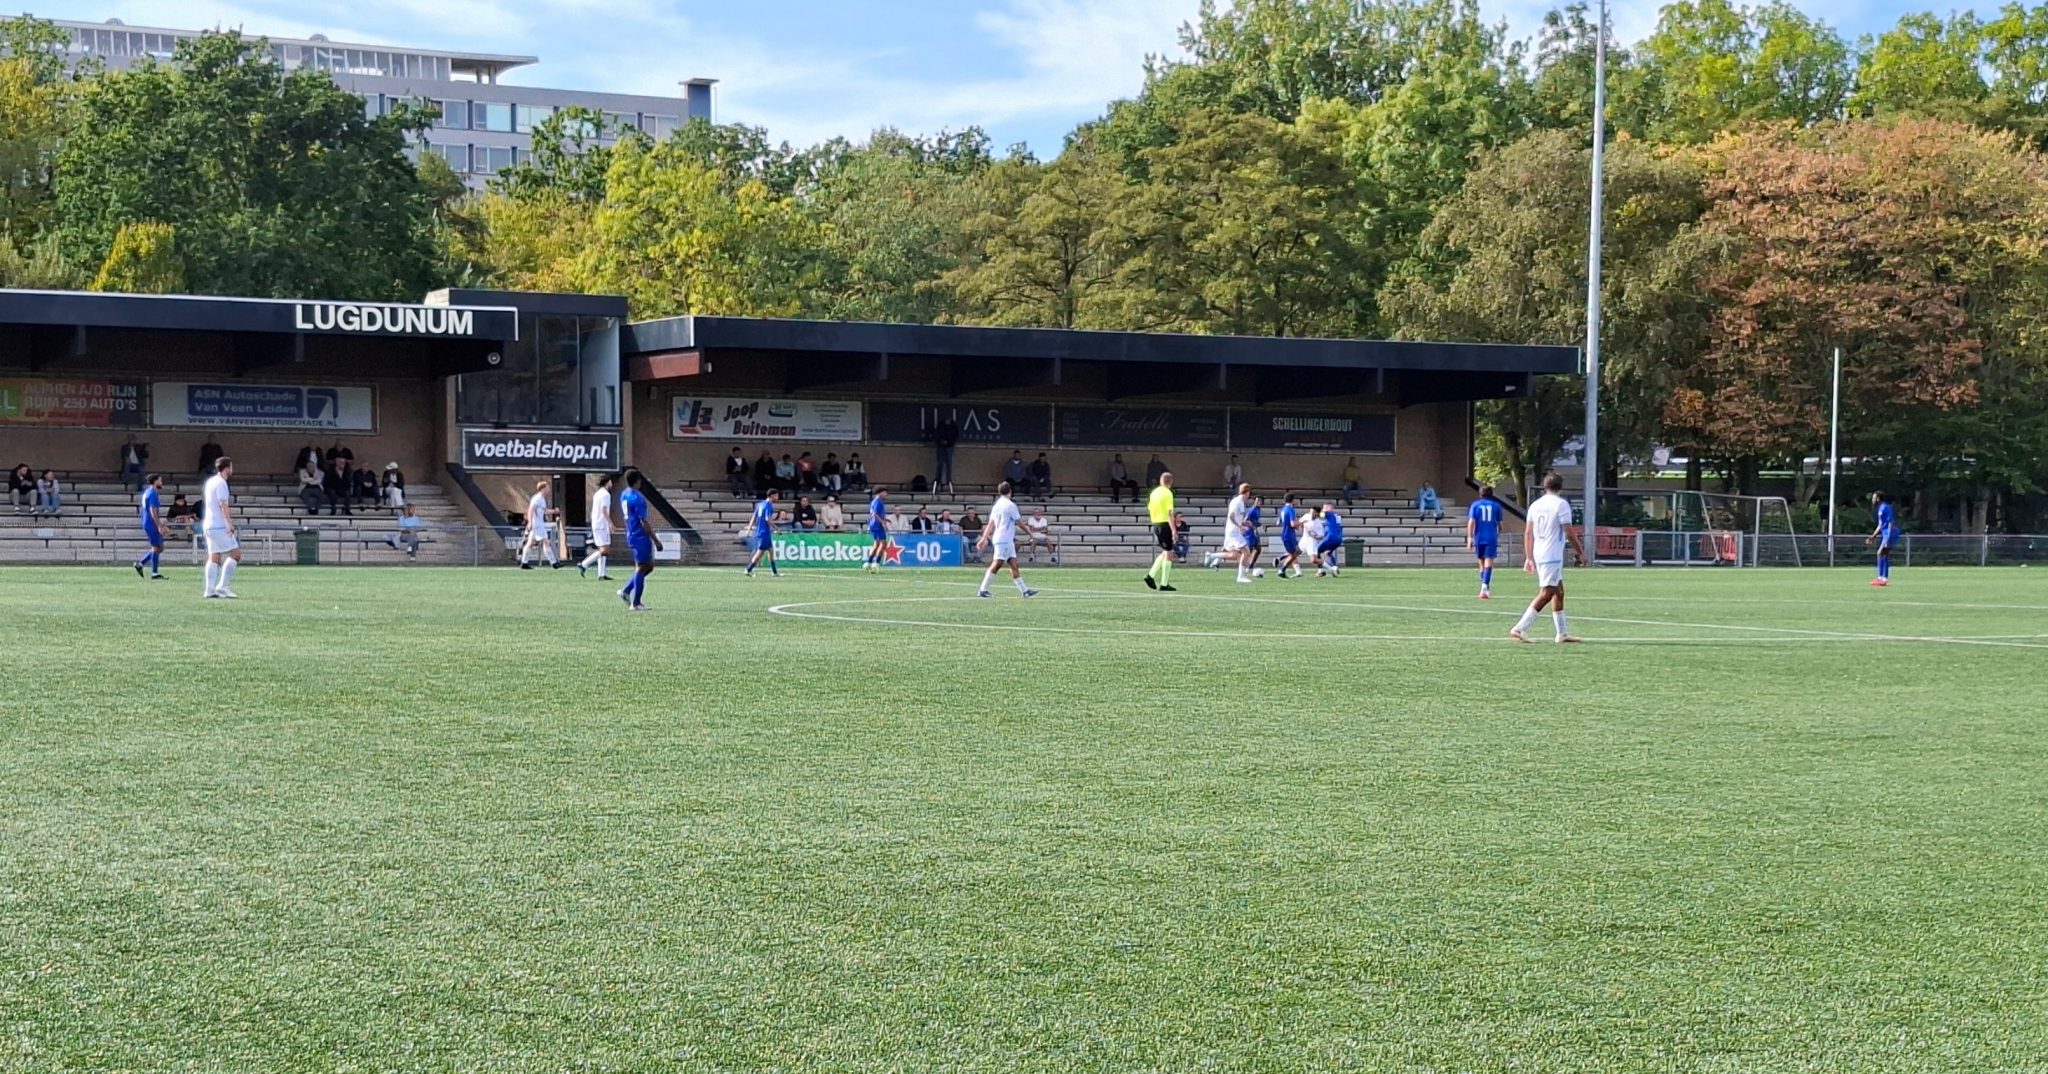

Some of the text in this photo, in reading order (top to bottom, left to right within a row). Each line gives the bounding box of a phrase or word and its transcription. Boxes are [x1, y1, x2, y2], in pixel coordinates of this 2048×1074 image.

[295, 303, 473, 335] LUGDUNUM
[80, 384, 103, 396] A/D
[107, 385, 137, 397] RIJN
[194, 389, 297, 401] ASN Autoschade
[0, 389, 17, 410] L
[62, 397, 87, 409] 250
[90, 398, 137, 410] AUTO'S
[195, 402, 298, 415] Van Veen Leiden
[723, 402, 759, 422] Joop
[733, 420, 797, 436] Buiteman
[474, 439, 608, 464] voetbalshop.nl
[1479, 505, 1493, 522] 11
